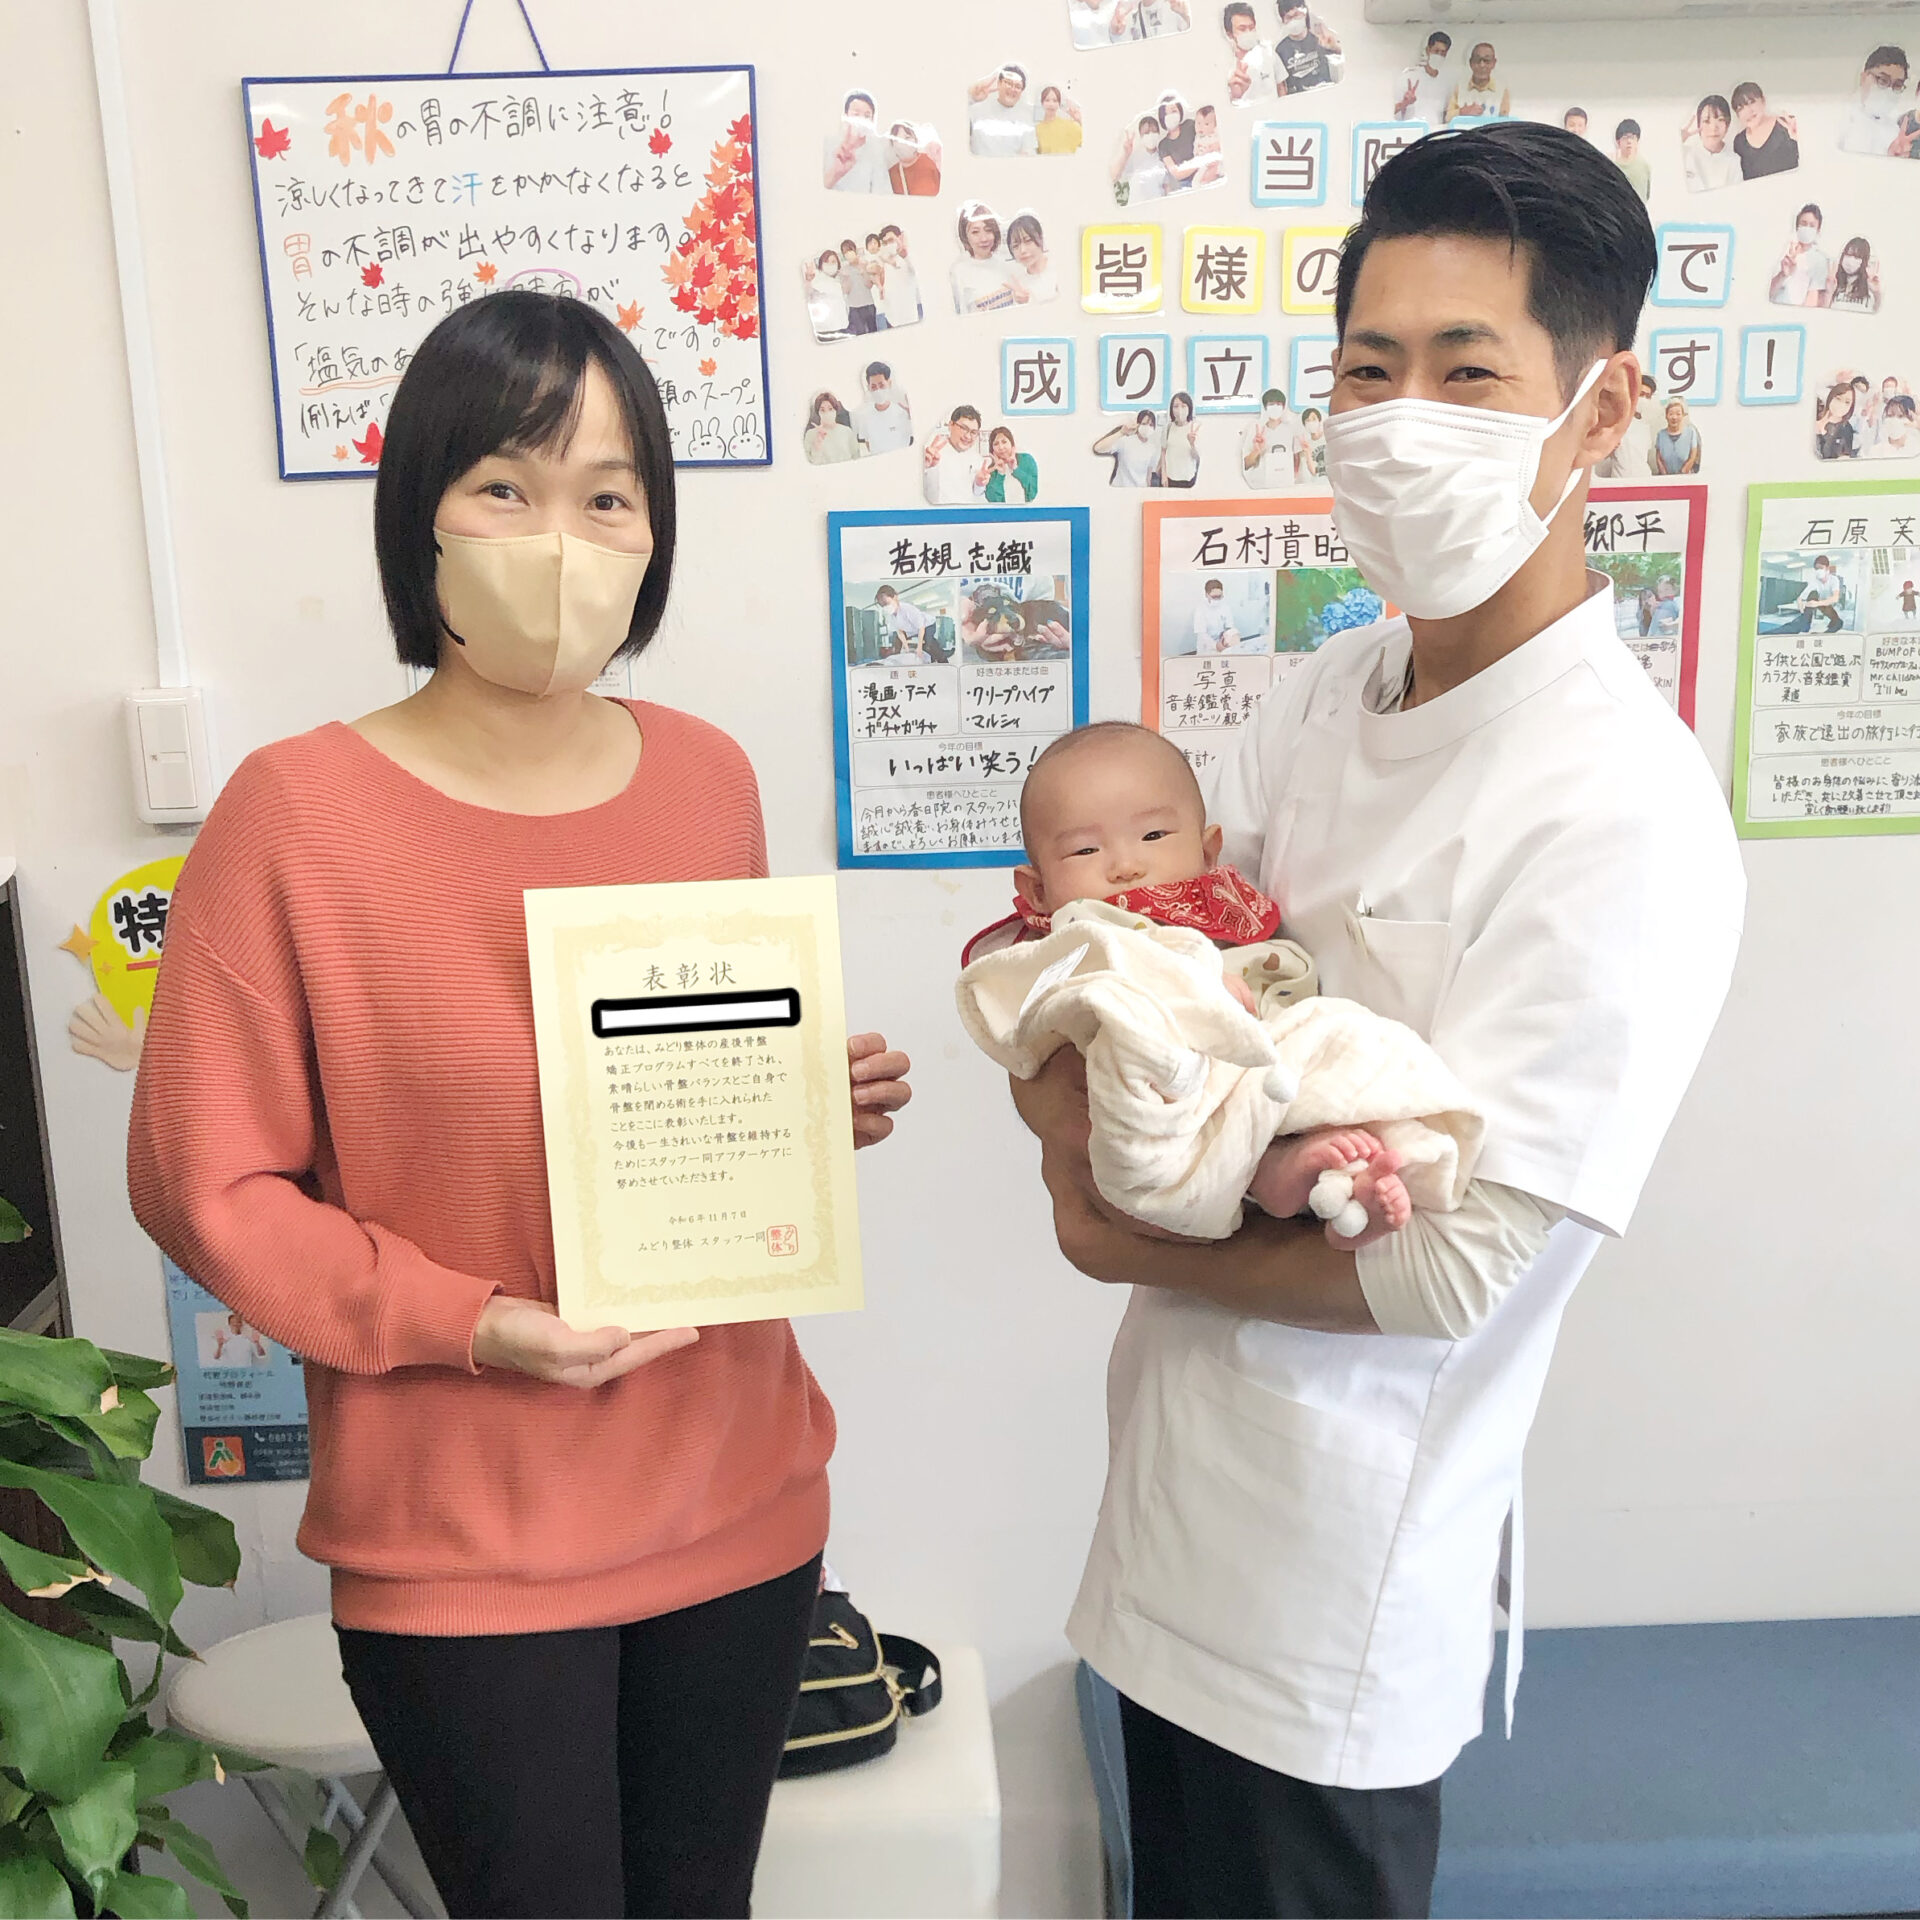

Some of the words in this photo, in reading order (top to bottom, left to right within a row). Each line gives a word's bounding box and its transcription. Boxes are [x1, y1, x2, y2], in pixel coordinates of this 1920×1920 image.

[1800, 518, 1869, 545] 石原
[976, 666, 1049, 677] 好きな本または曲
[1165, 693, 1262, 712] 音楽鑑賞・楽
[938, 741, 984, 752] 今年の目標
[642, 960, 737, 991] 表彰状
[604, 1035, 768, 1057] あなたは、みどり整体の産後骨盤
[607, 1071, 788, 1095] 素晴らしい骨盤バランスとご自身で
[610, 1112, 743, 1132] ことをここに表彰いたします。
[613, 1128, 792, 1151] 今後も一生きれいな骨盤を維持する
[616, 1170, 735, 1190] 努めさせていただきます。
